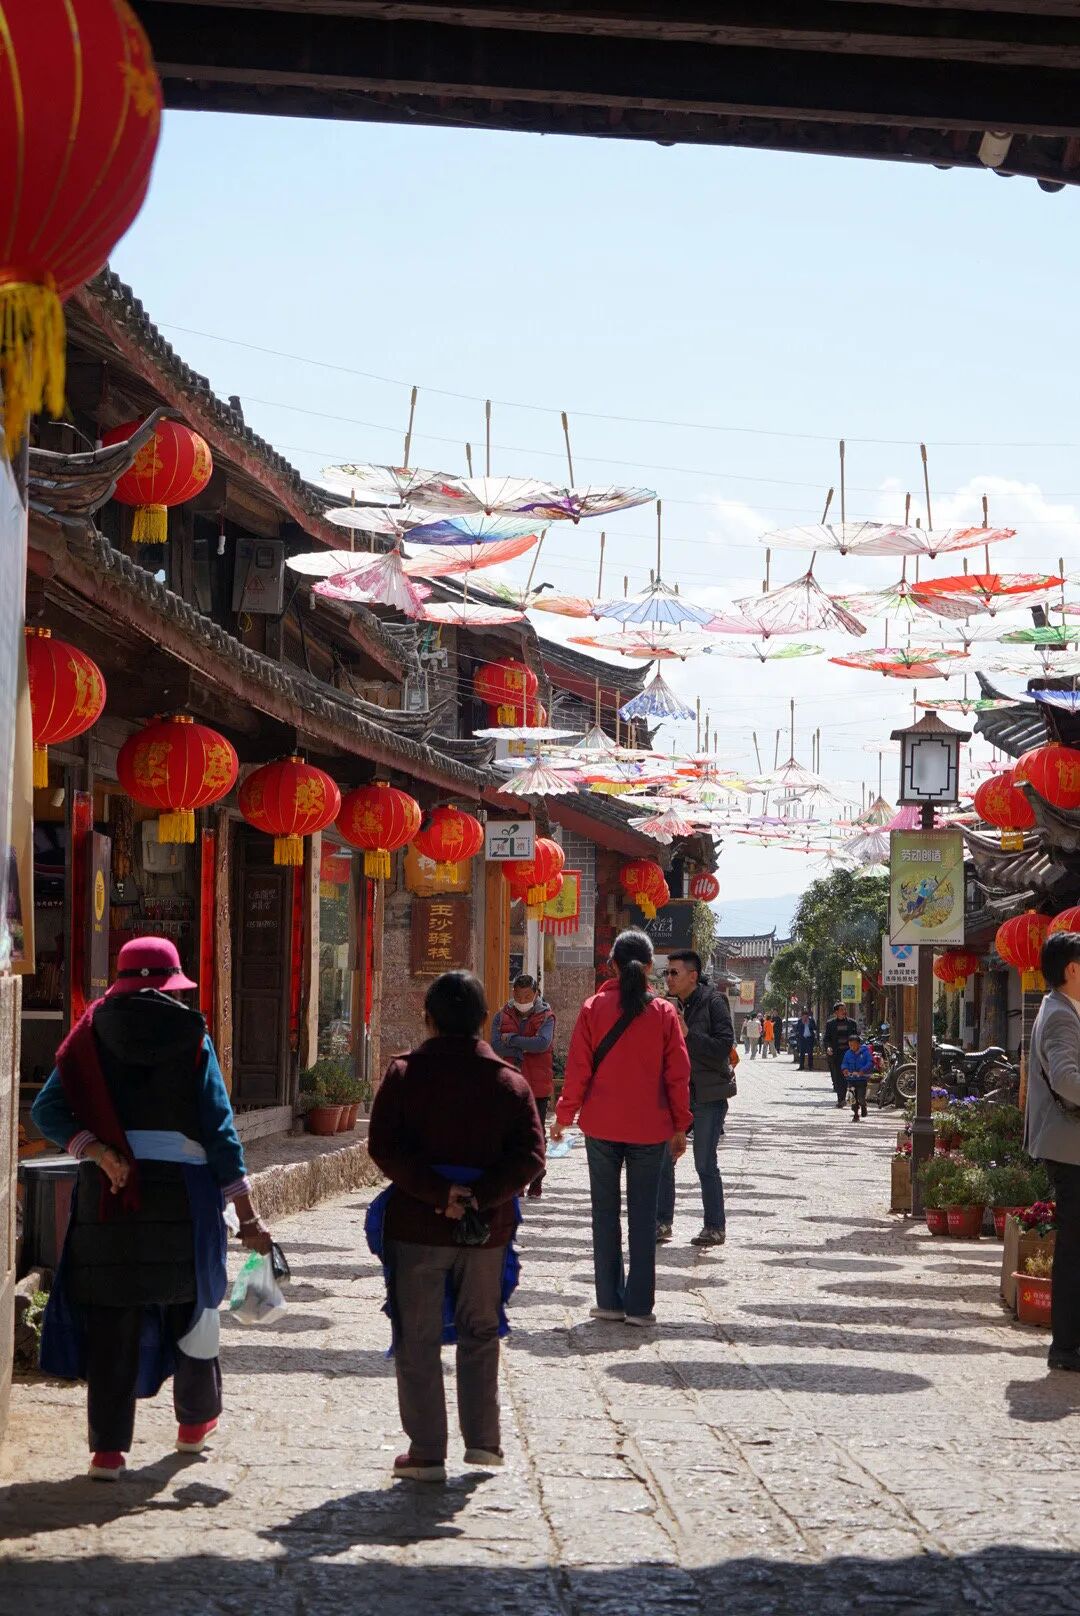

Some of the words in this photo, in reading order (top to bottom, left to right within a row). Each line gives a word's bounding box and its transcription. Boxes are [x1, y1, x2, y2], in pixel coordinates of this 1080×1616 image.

[901, 849, 941, 862] 劳动创造
[695, 878, 715, 896] illy
[428, 904, 454, 960] 玉沙驿栈
[651, 923, 673, 932] SEA
